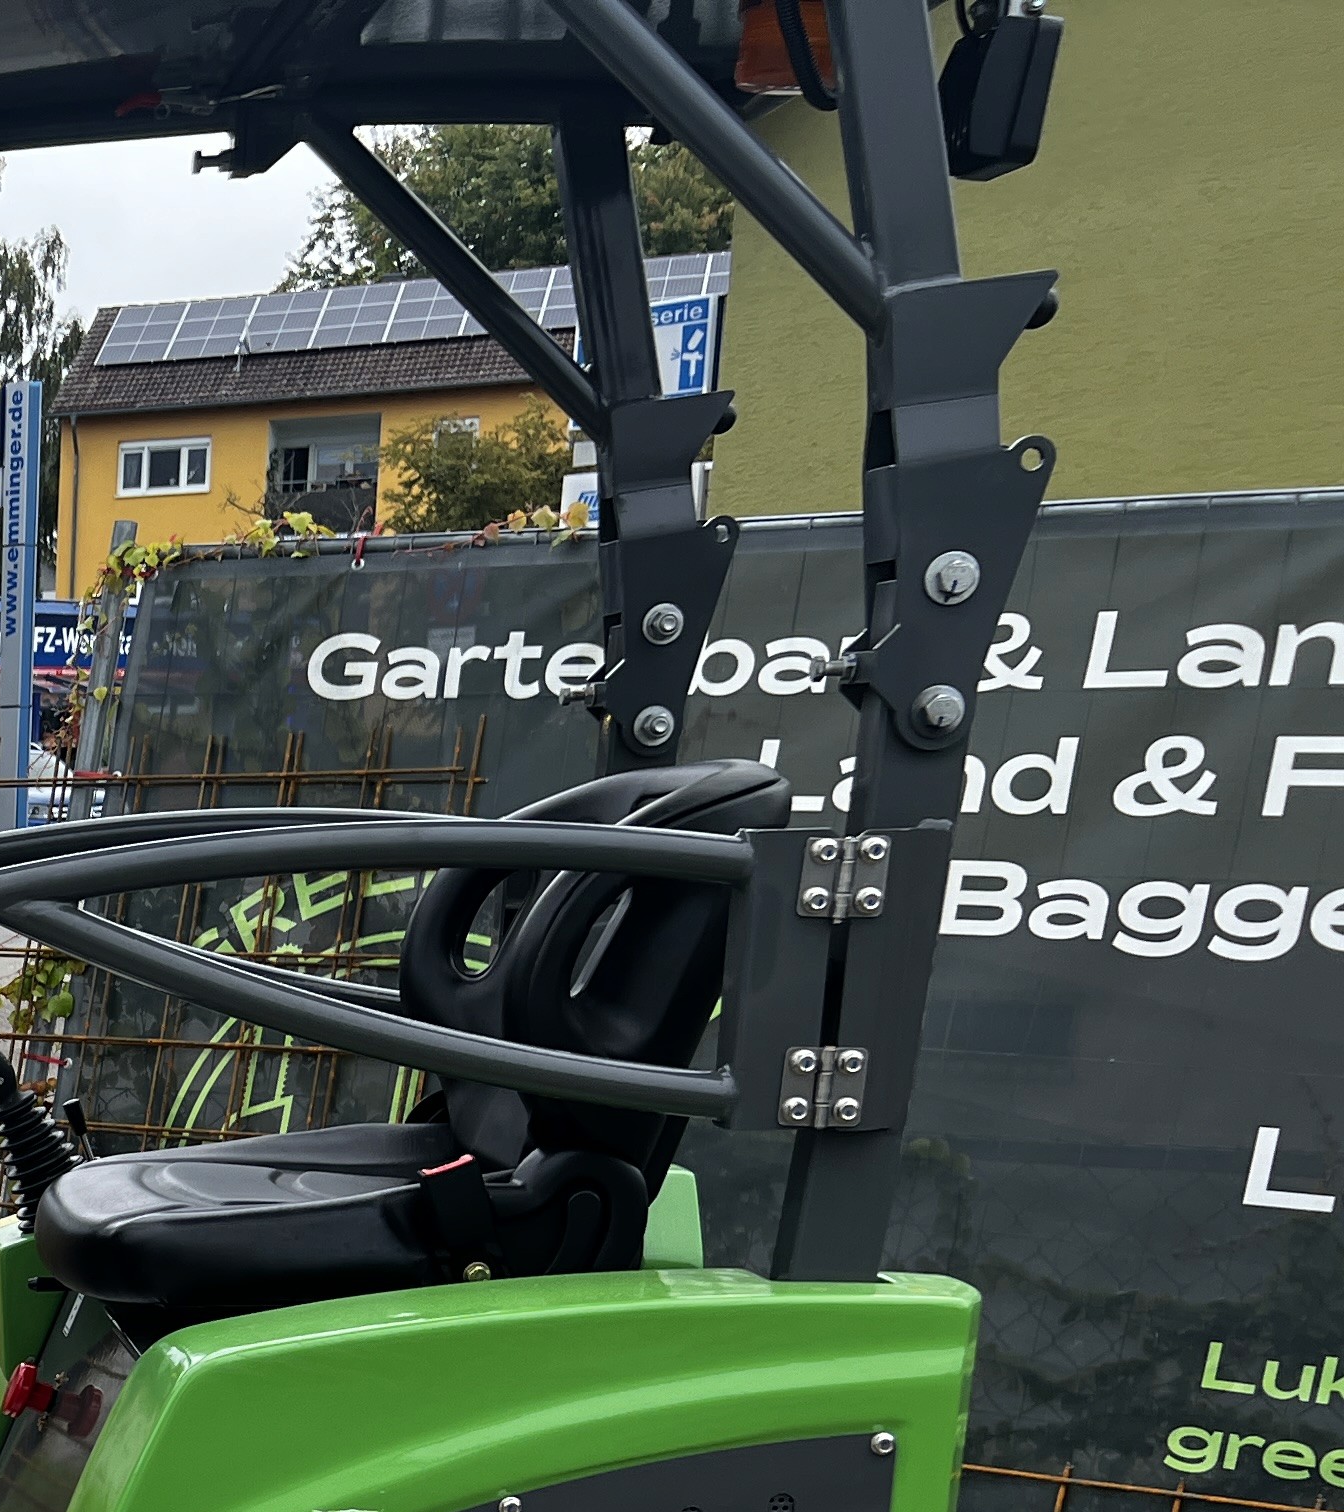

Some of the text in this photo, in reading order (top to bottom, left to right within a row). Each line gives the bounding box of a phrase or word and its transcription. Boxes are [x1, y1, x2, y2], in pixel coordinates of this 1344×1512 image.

[650, 303, 703, 326] serie
[5, 389, 24, 637] www.emminger.de
[977, 611, 1044, 693] &
[1113, 735, 1218, 817] &
